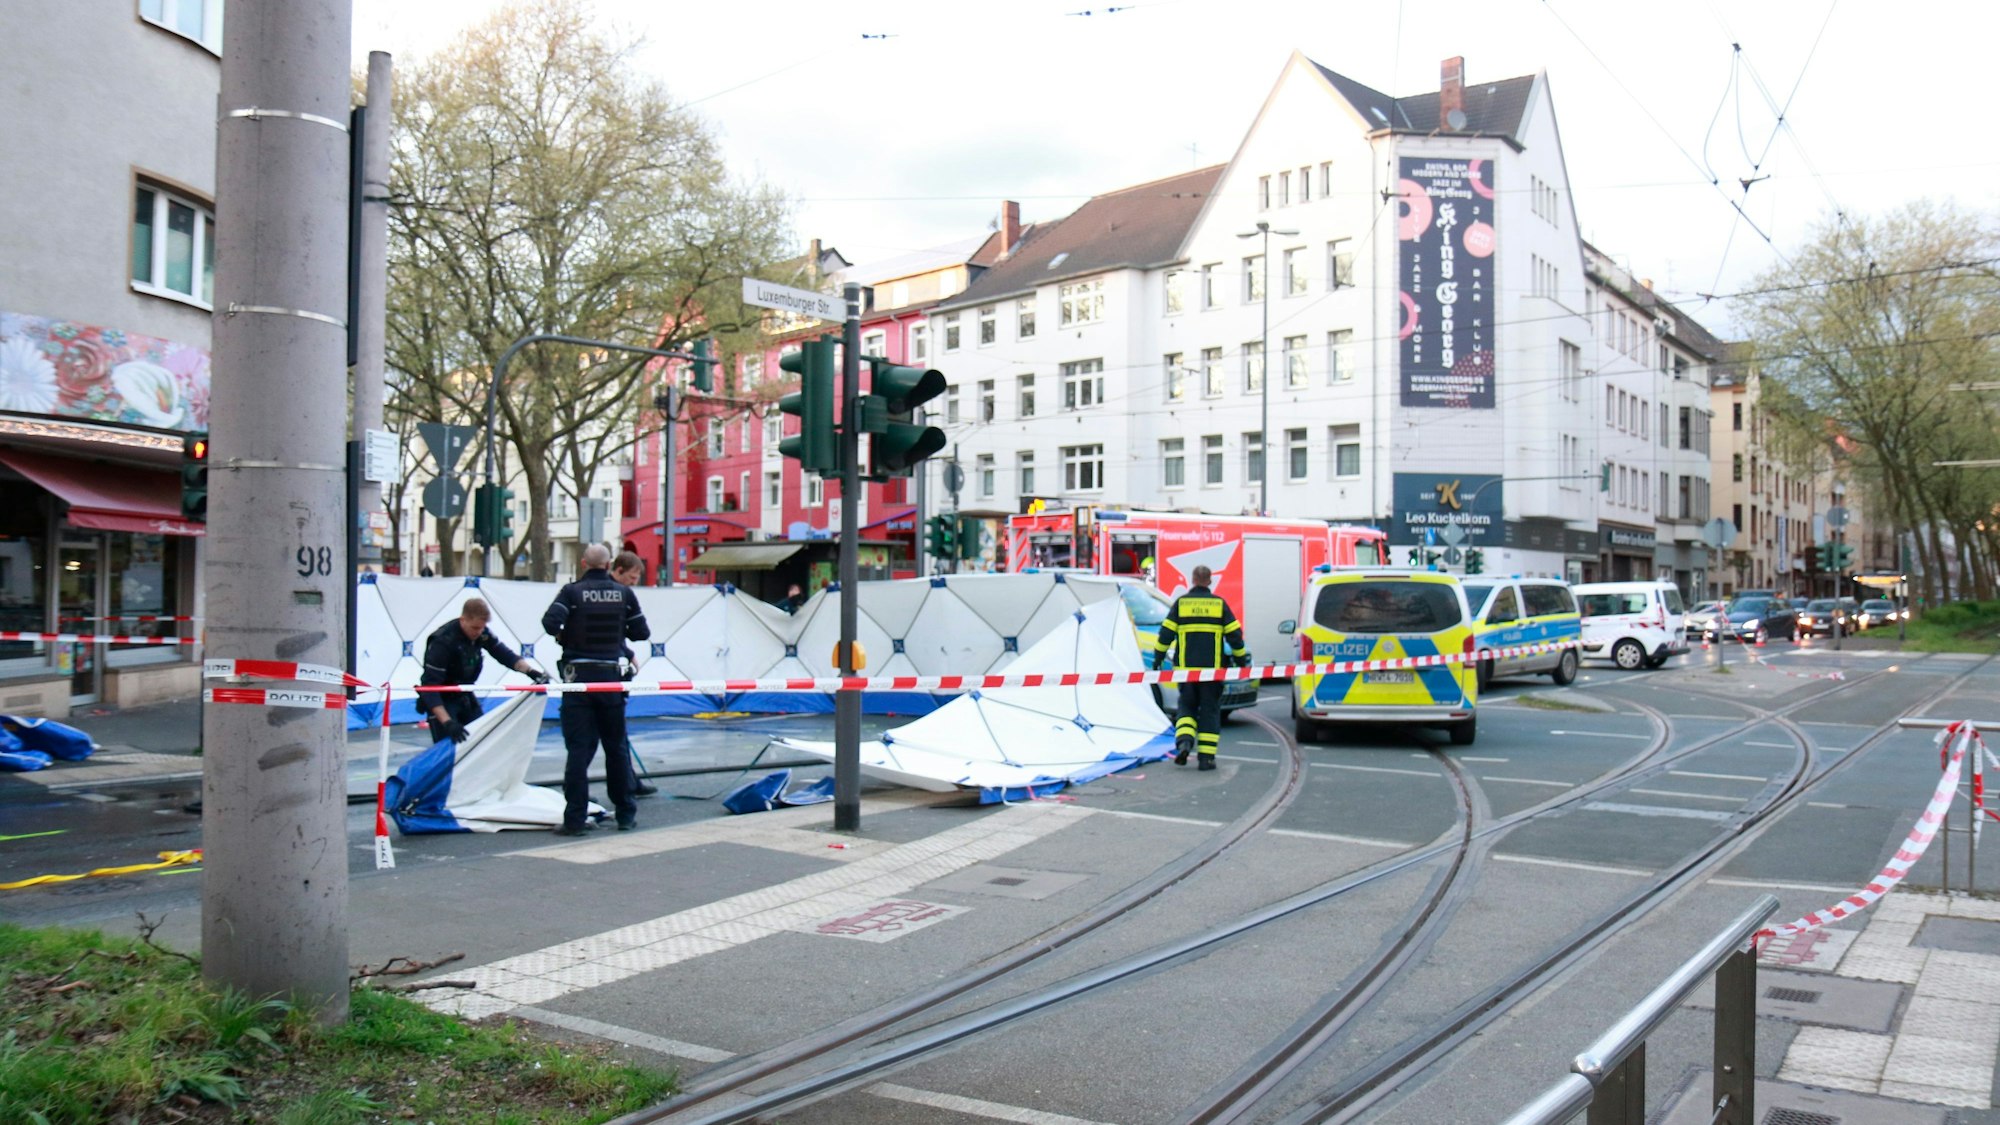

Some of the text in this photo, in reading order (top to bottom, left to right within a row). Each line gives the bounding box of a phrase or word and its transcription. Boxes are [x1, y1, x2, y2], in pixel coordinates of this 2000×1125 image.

[1412, 169, 1443, 178] MODERN
[1444, 171, 1460, 179] AND
[1436, 203, 1457, 279] King
[757, 286, 832, 315] Luxemburger Str.
[1436, 281, 1458, 368] Georg
[1406, 512, 1490, 524] Leo Kuckelkorn
[1160, 529, 1224, 541] Feuerwehr 112
[297, 546, 332, 577] 98
[582, 590, 623, 602] POLIZEI
[1192, 607, 1209, 615] KÖLN
[1315, 643, 1370, 656] POLIZEI
